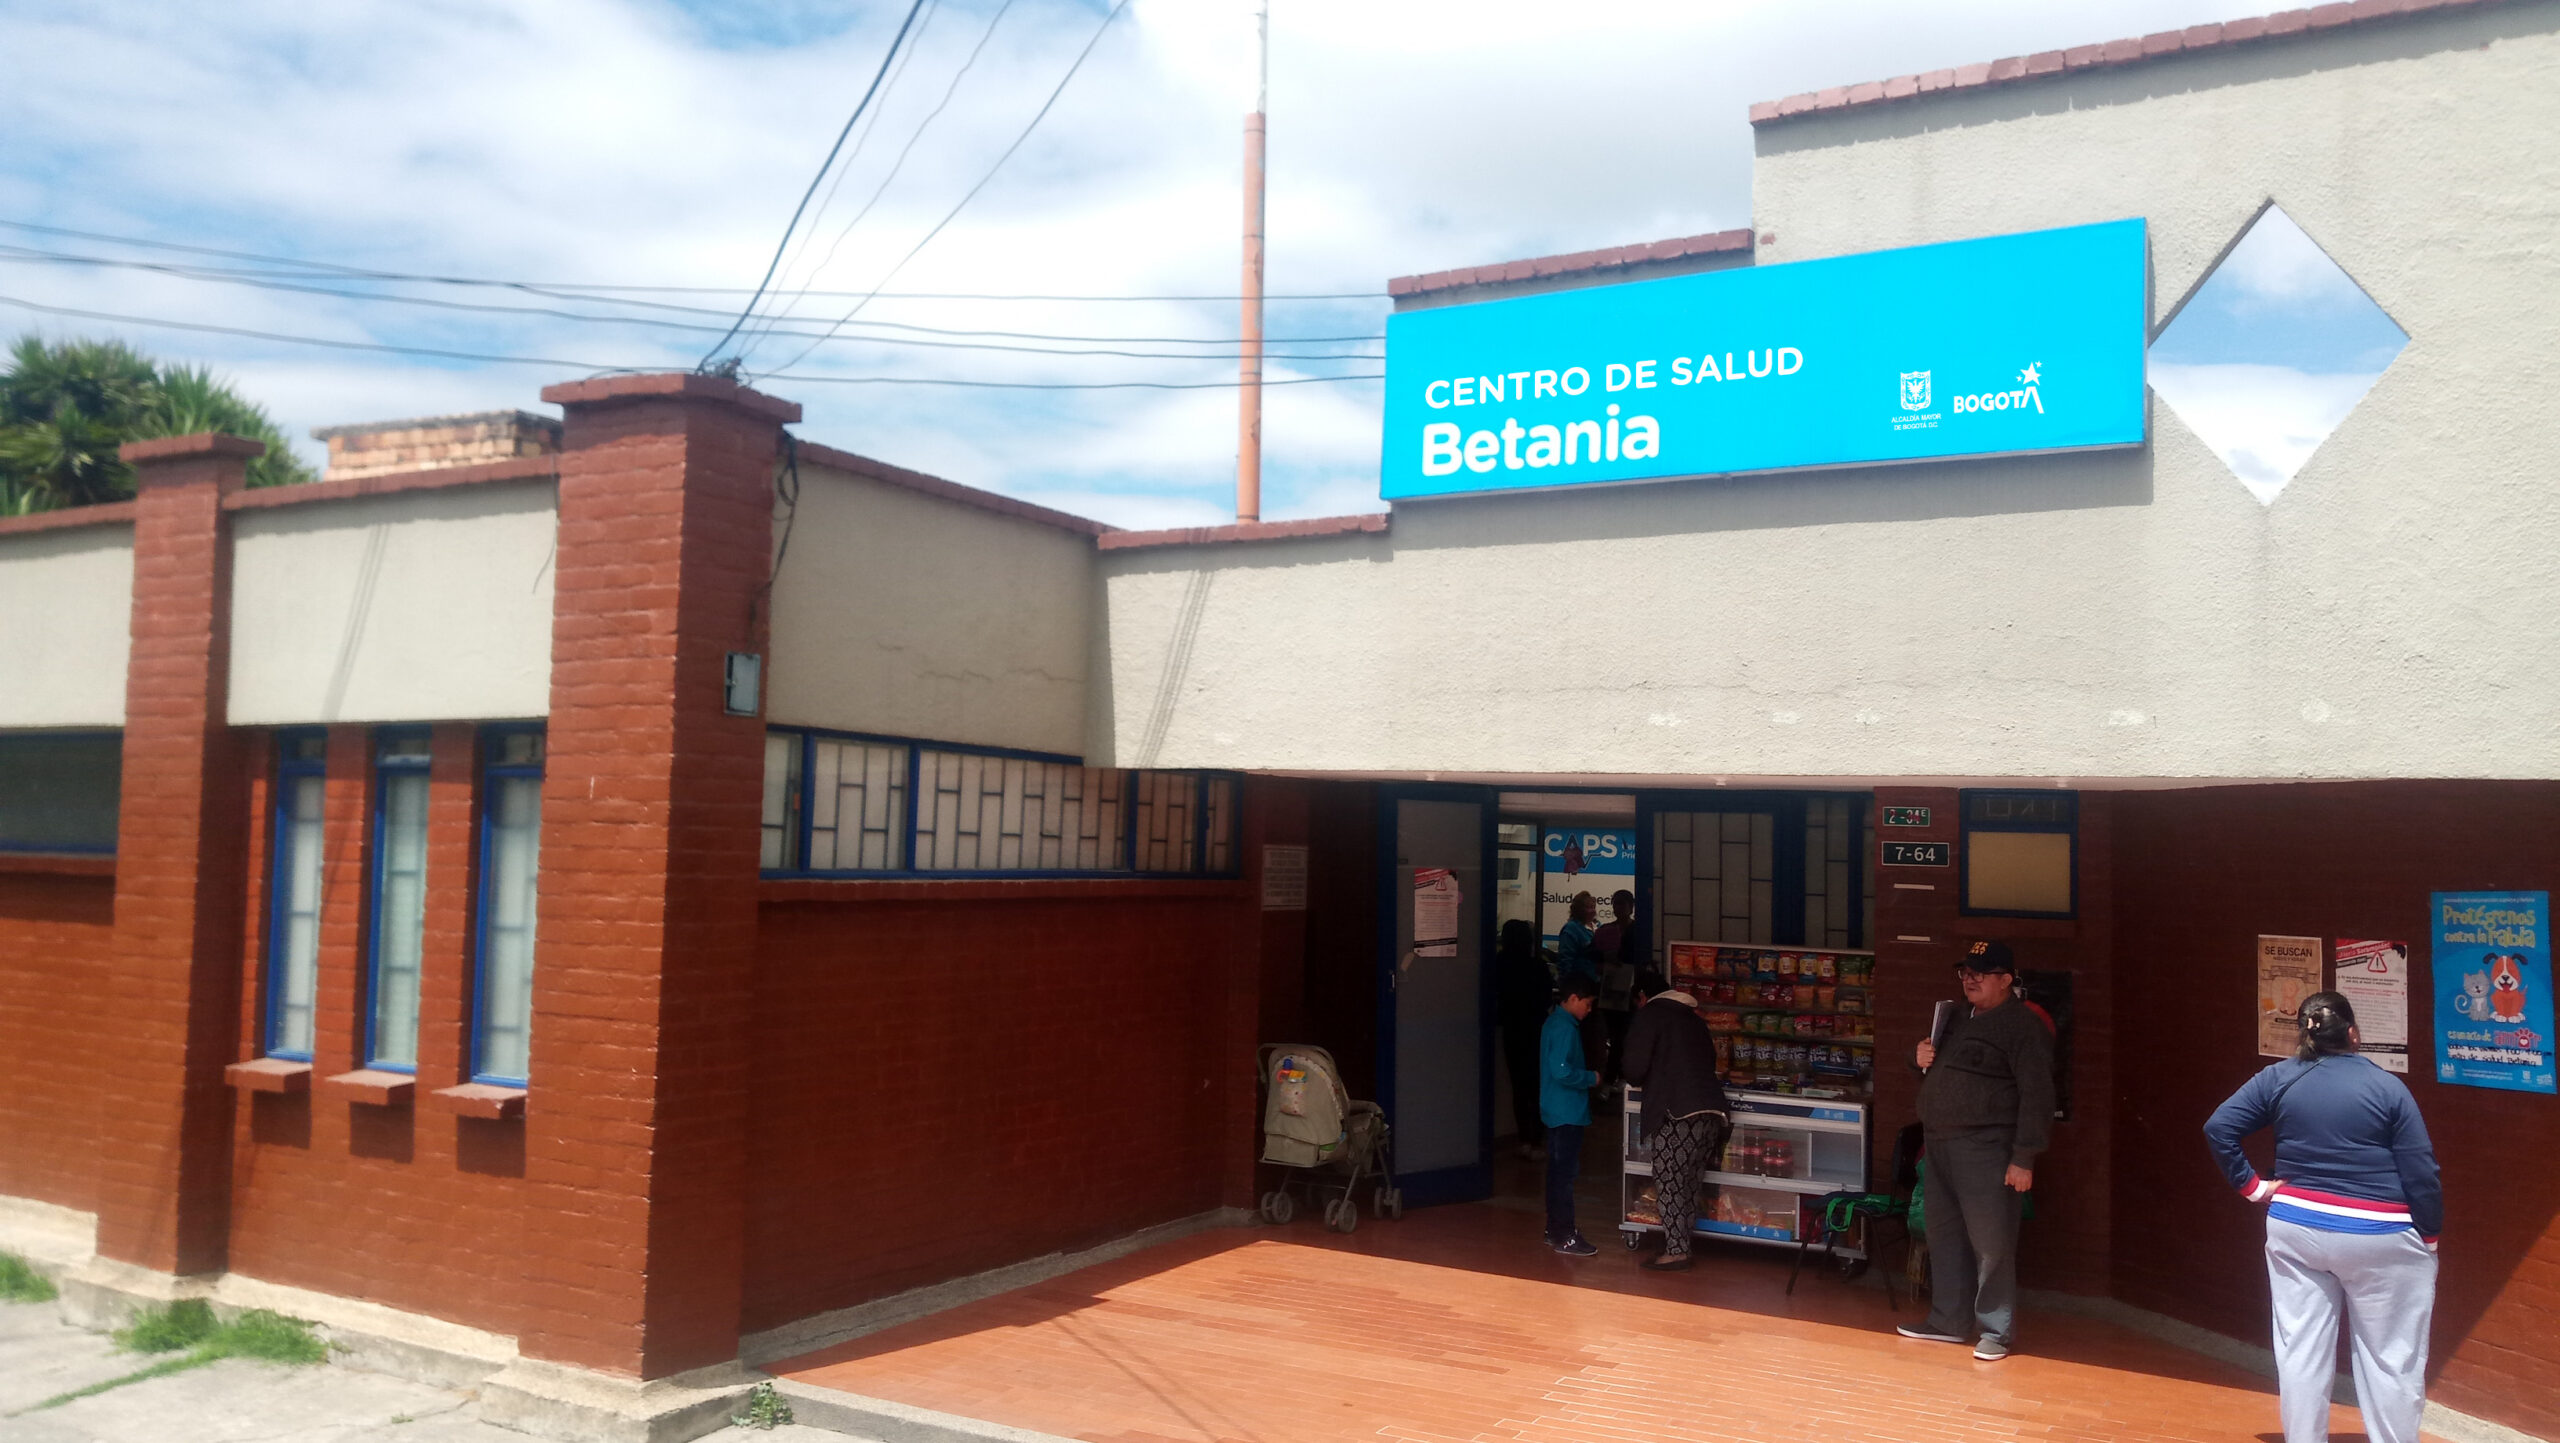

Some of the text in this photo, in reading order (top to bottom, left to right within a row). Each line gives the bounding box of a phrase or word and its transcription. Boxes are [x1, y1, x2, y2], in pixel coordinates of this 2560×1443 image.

[1424, 348, 1804, 408] CENTRO DE SALUD
[1921, 413, 1942, 421] MAYOR
[1422, 404, 1660, 476] Betania
[1544, 832, 1618, 858] CAPS
[1895, 846, 1935, 861] 7-64
[1542, 892, 1573, 904] Salud
[2442, 904, 2536, 931] Protégenos
[2477, 928, 2488, 943] la
[2488, 926, 2536, 949] rabia
[2264, 946, 2313, 957] SE BUSCAN
